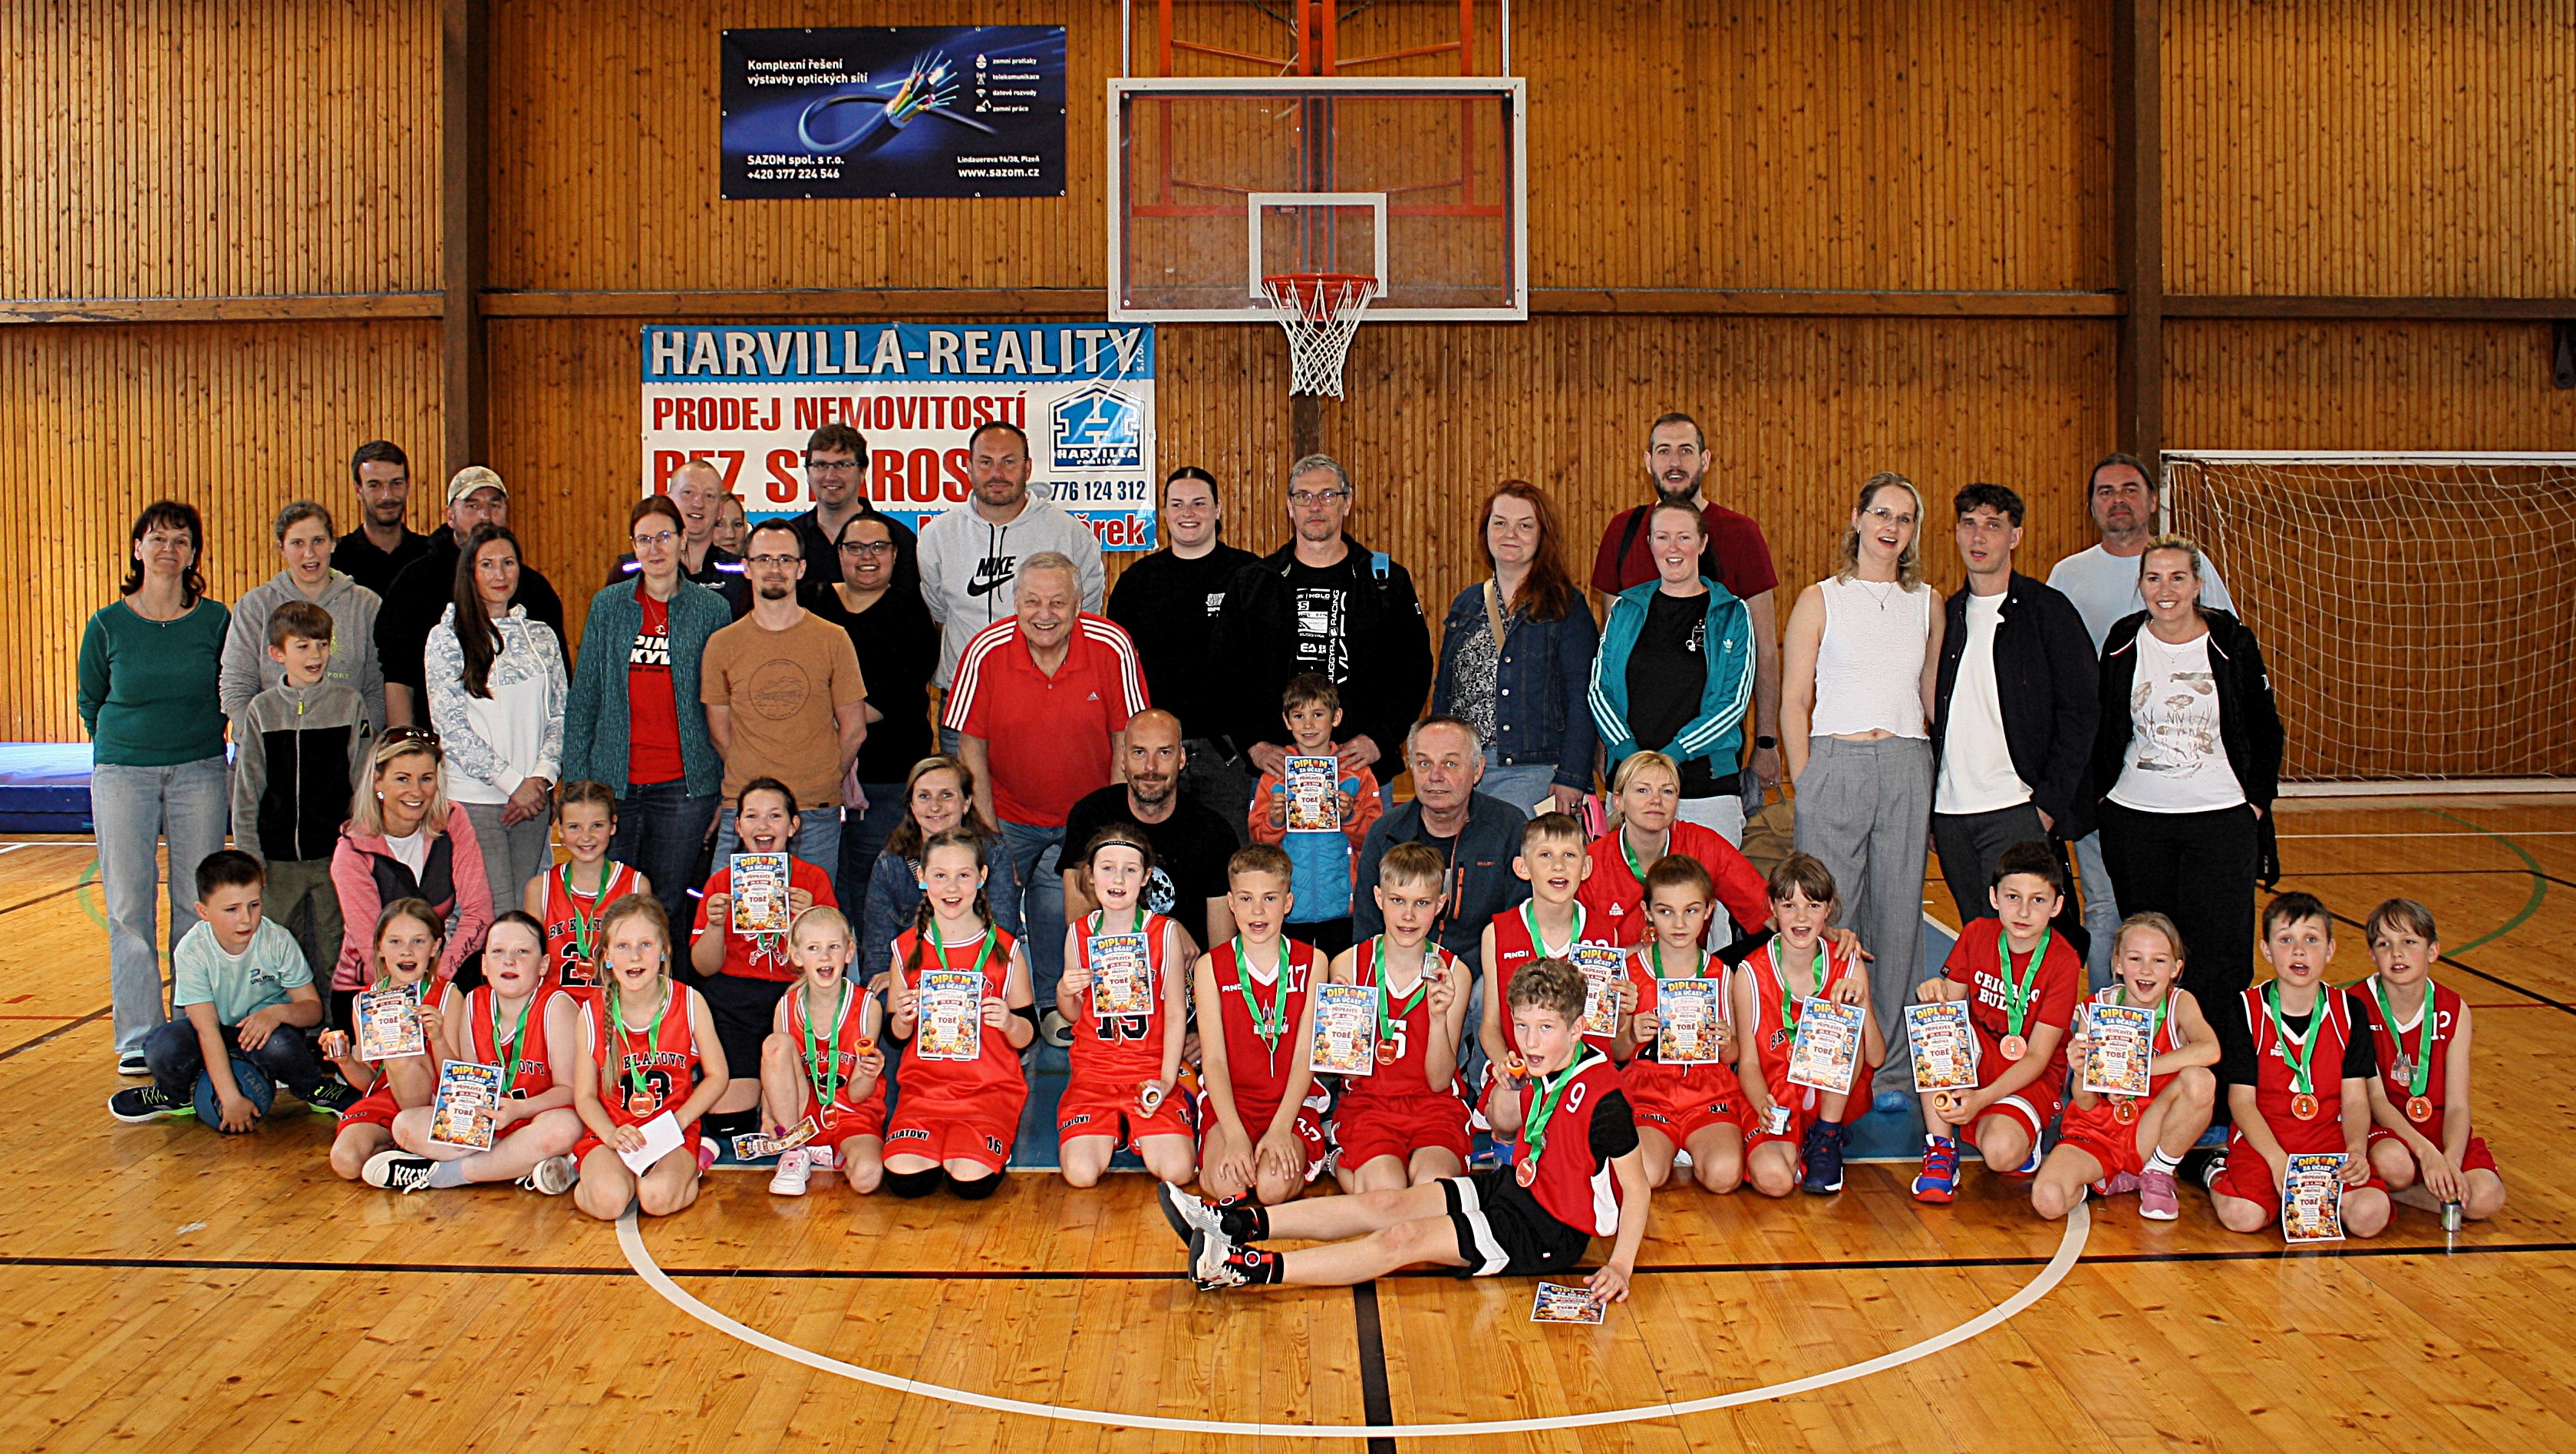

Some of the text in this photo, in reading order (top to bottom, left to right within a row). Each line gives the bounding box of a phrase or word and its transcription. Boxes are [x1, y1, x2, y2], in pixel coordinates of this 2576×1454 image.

[747, 58, 843, 72] Komplexní řešení
[747, 71, 868, 87] výstavby optických sítí
[747, 154, 845, 167] SAZOM spol. s r.o.
[747, 168, 840, 180] +420 377 224 546
[958, 168, 1040, 177] www.sazom.cz
[651, 328, 1142, 376] HARVILLA-REALITY
[652, 390, 1028, 431] PRODEJ NEMOVITOSTÍ
[1057, 449, 1138, 460] HARVILLA
[1049, 480, 1146, 501] 776 124 312
[1330, 589, 1340, 625] RACING
[549, 921, 565, 940] BK
[1285, 963, 1308, 994] 17
[1813, 1046, 1833, 1055] TOBĚ
[1930, 1048, 1949, 1057] TOBĚ
[2106, 1050, 2127, 1059] TOBĚ
[1565, 1082, 1586, 1113] 9
[454, 1108, 473, 1116] TOBĚ
[985, 1135, 1003, 1156] 16
[2301, 1198, 2319, 1206] TOBĚ
